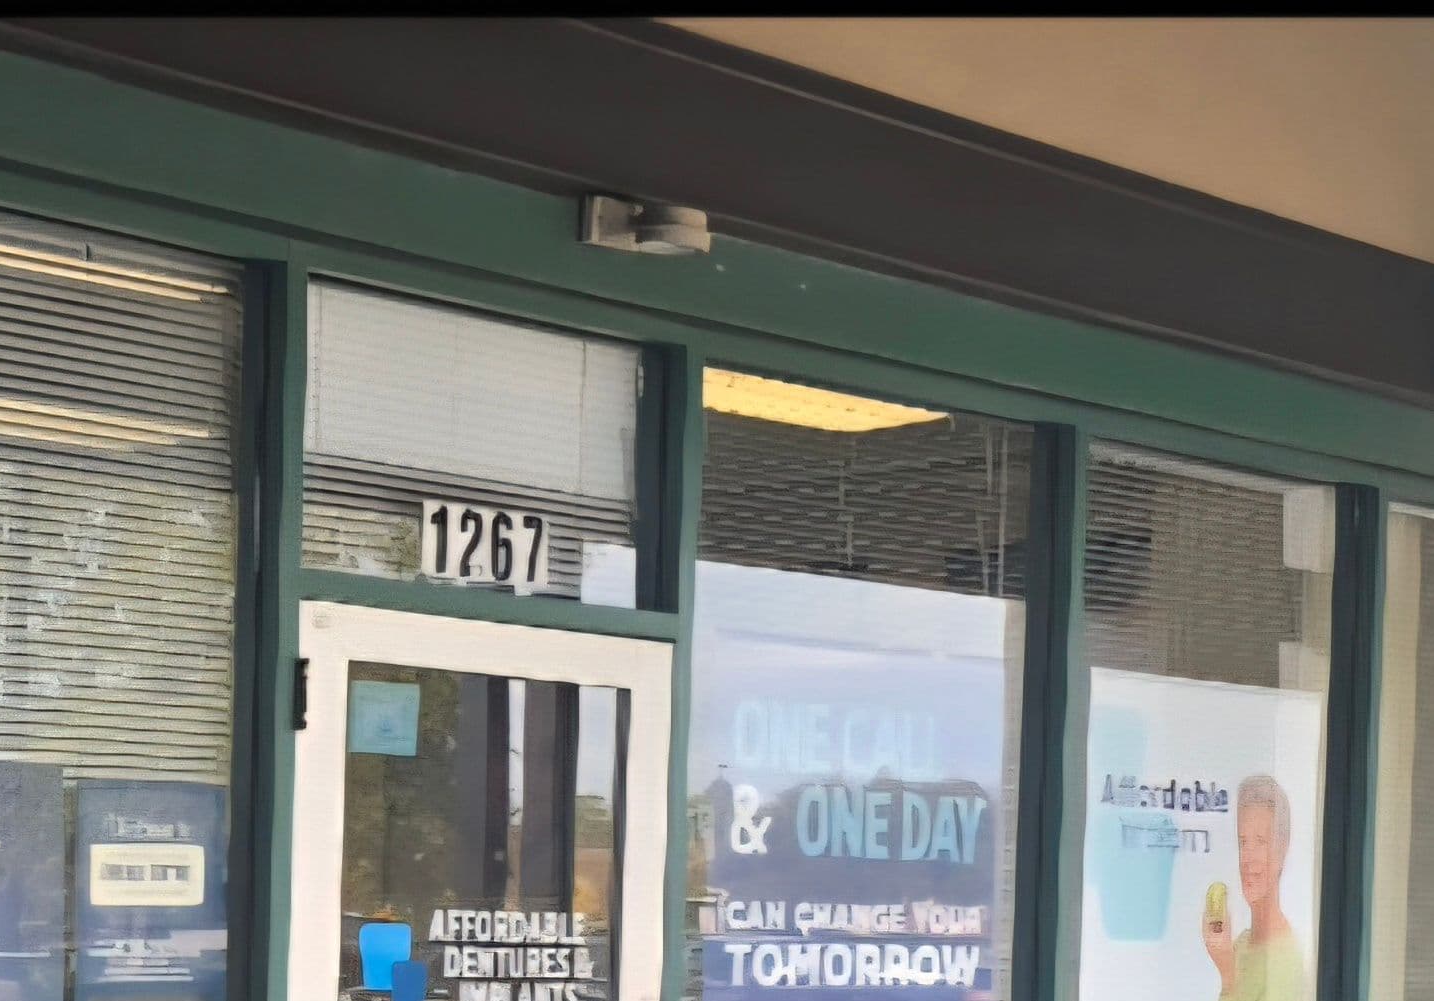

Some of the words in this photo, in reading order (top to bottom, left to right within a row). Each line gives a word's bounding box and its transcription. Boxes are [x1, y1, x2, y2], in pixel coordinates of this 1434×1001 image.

[429, 504, 544, 583] 1267
[734, 701, 830, 771] ONE
[1101, 774, 1229, 813] Aordable
[730, 783, 773, 855] &
[796, 784, 893, 860] ONE
[900, 788, 988, 865] DAY
[725, 900, 787, 931] CAN
[443, 944, 571, 978] DENTURES
[723, 943, 981, 988] TOMORROW
